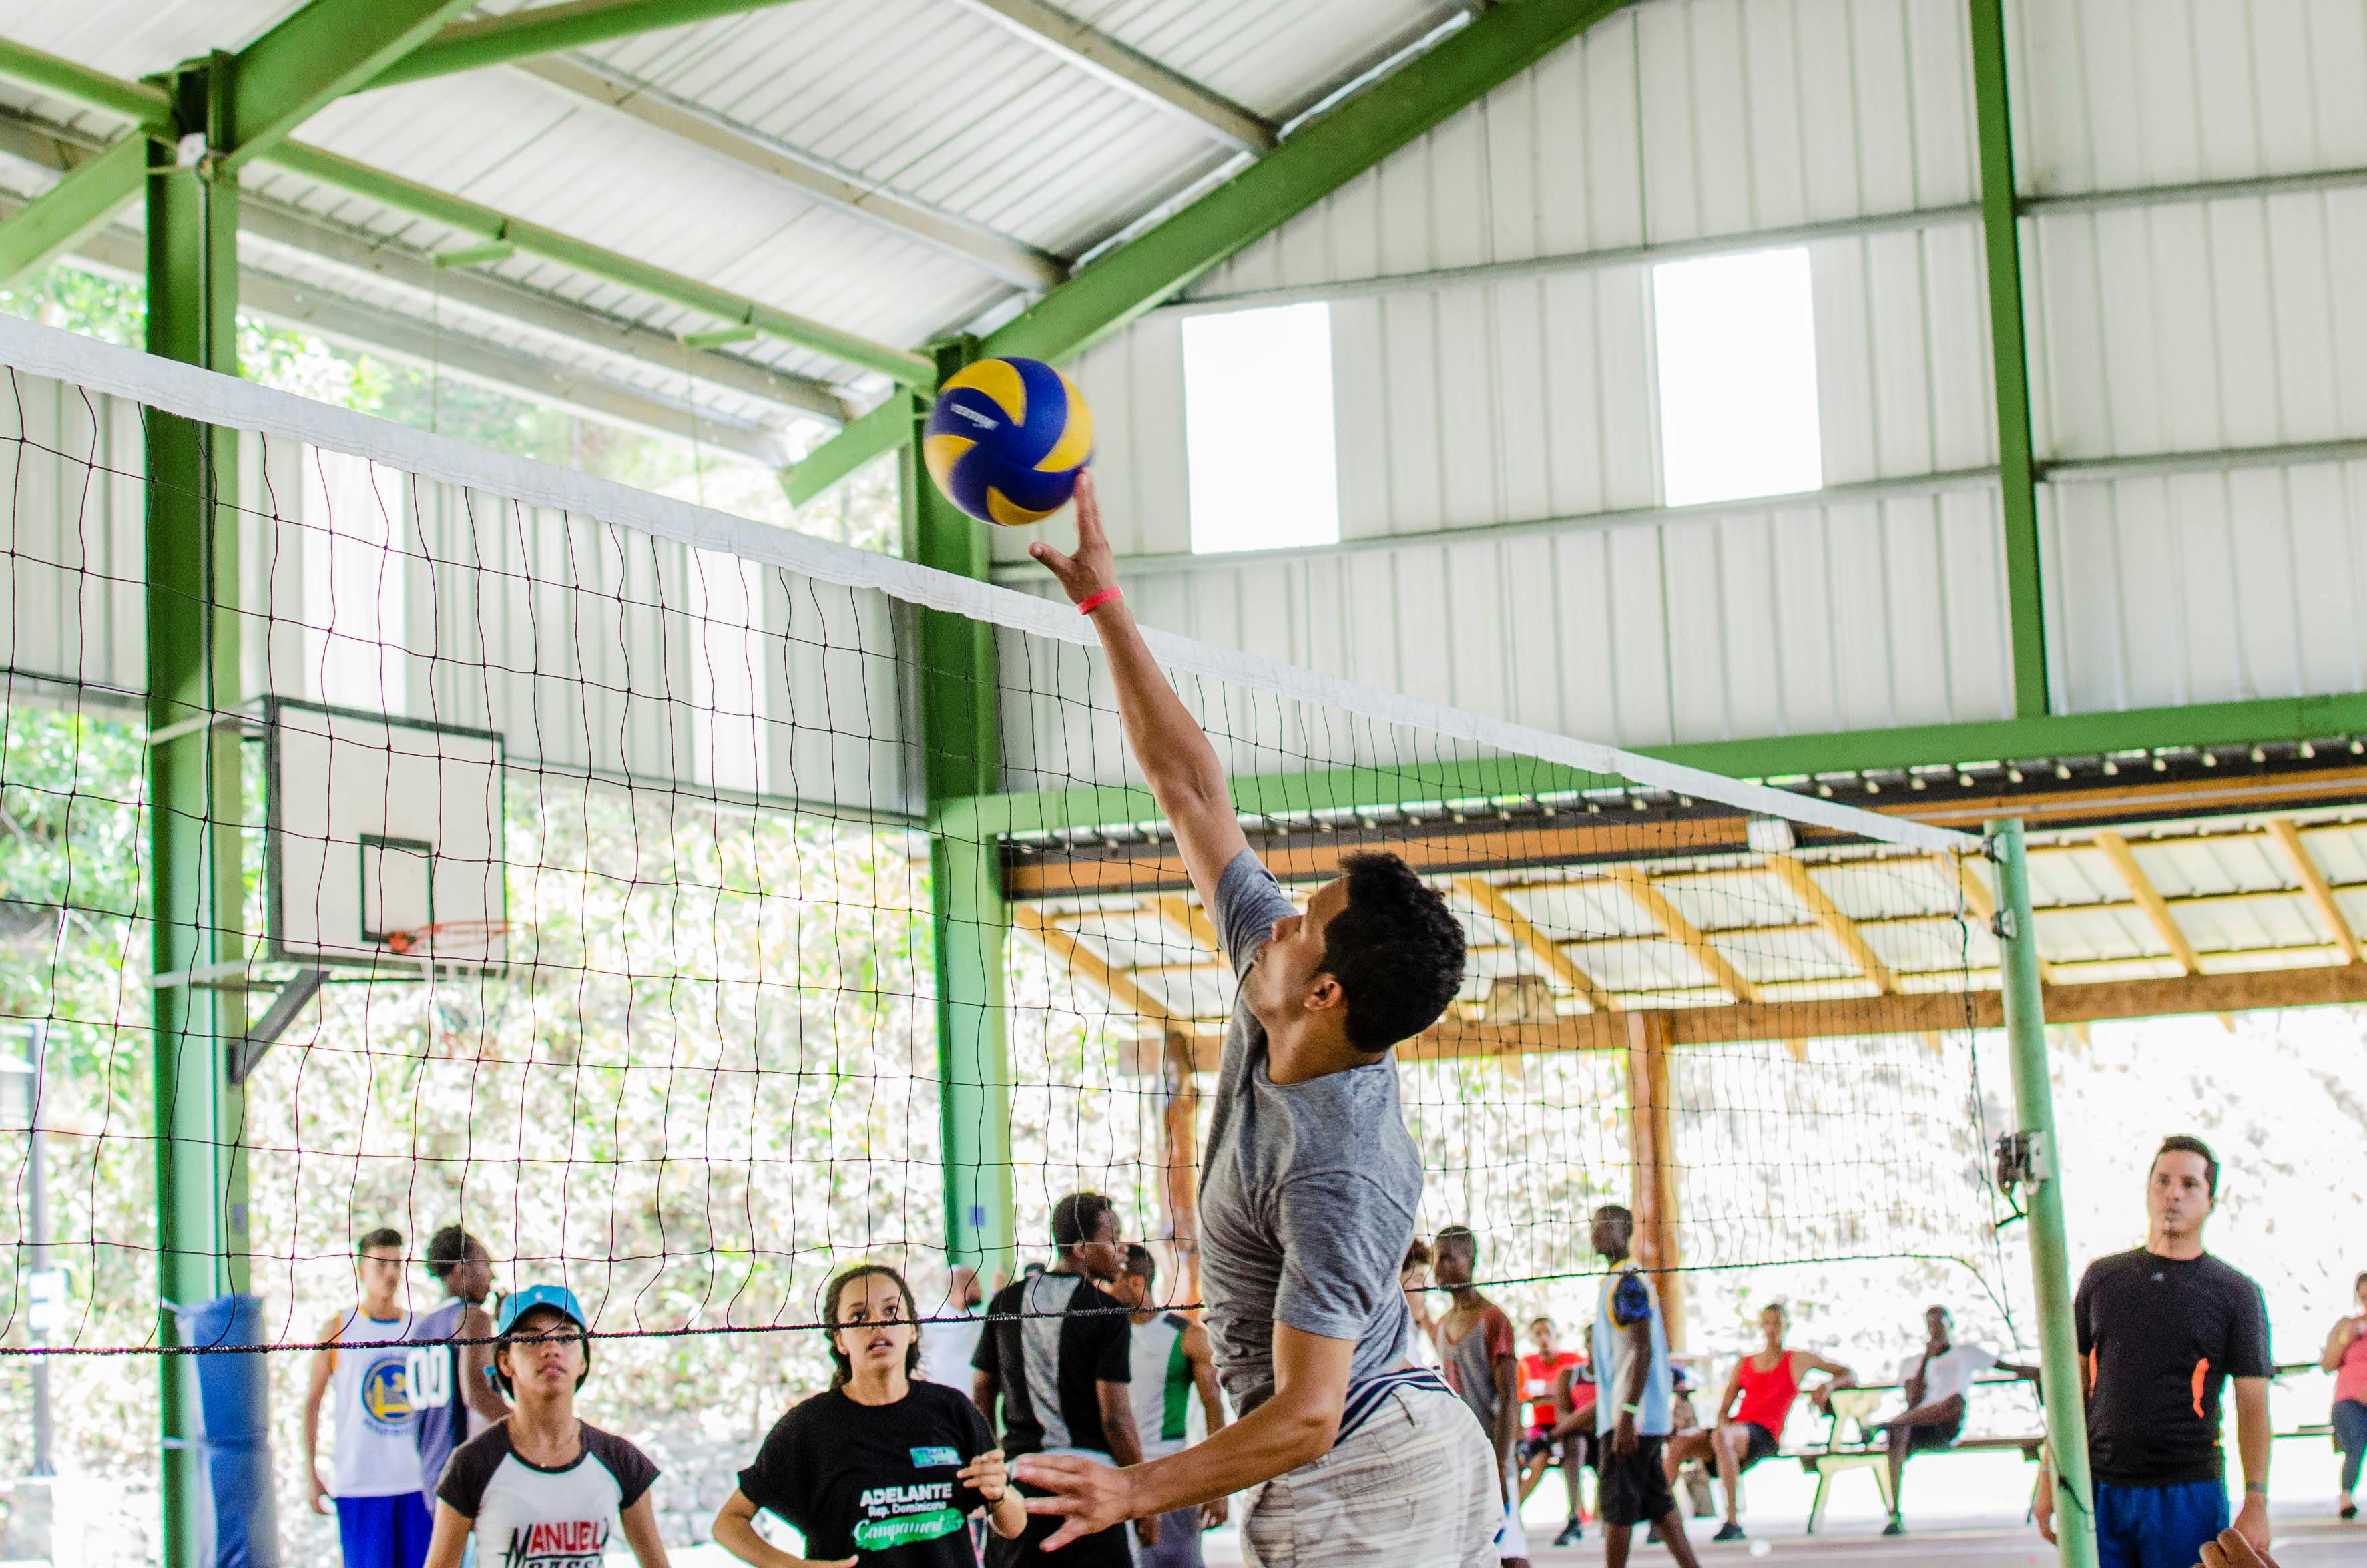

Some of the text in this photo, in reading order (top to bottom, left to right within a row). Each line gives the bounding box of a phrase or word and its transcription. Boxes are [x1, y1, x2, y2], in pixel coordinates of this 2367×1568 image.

[859, 1482, 953, 1507] ADELANTE
[868, 1505, 890, 1519] Rep.
[499, 1521, 602, 1567] MANUEL
